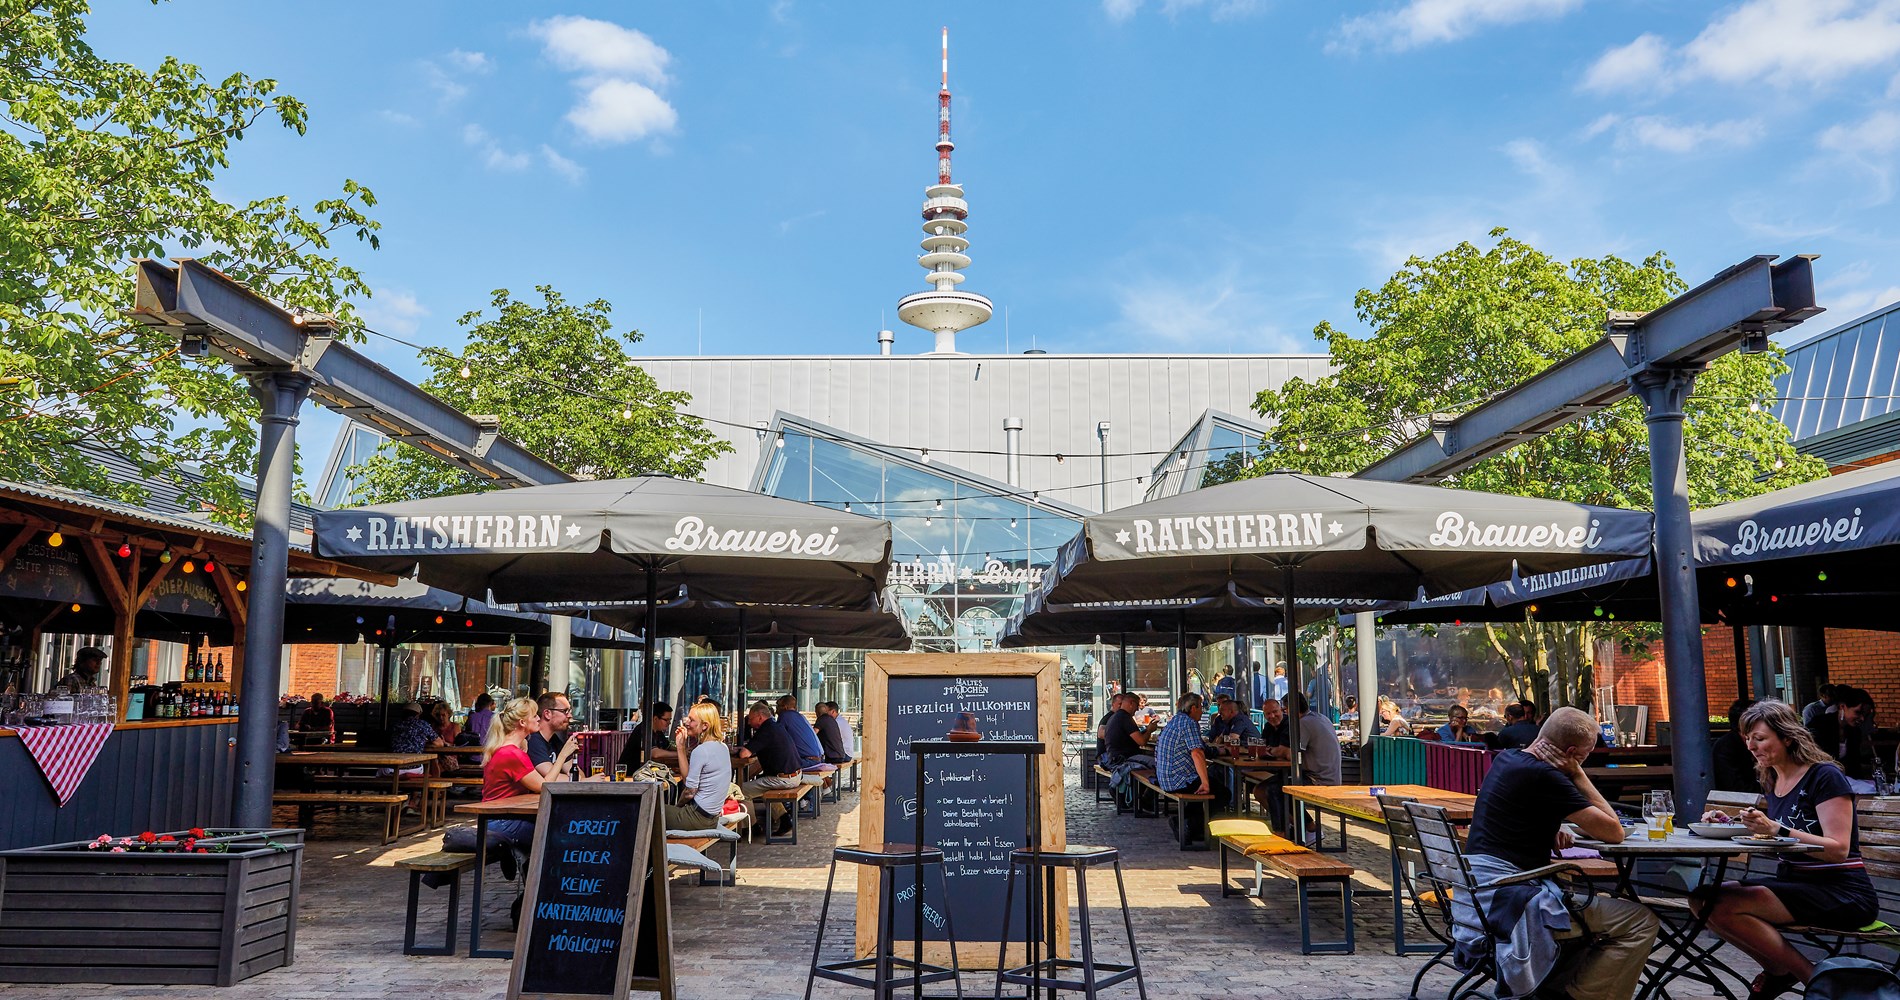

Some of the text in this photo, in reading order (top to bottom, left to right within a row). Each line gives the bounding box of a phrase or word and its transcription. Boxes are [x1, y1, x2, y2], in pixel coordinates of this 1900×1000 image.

[367, 515, 839, 556] RATSHERRN Brauerei
[1134, 511, 1602, 553] RATSHERRN Brauerei
[1731, 507, 1863, 556] Brauerei
[16, 558, 41, 573] BITTE
[886, 562, 956, 584] HERRN
[979, 560, 1043, 584] Brau
[159, 578, 218, 607] BIERAUSGABE
[960, 701, 1031, 712] WILLKOMMEN
[894, 750, 910, 760] Bitte
[923, 771, 934, 785] So
[962, 808, 993, 822] Bestellung
[995, 808, 1004, 818] ist
[568, 820, 620, 836] DERZEIT
[942, 835, 1016, 848] Wenn Ihr noch Essen
[562, 850, 611, 865] LEIDER
[989, 851, 1004, 861] lasst
[960, 864, 980, 876] Buzzer
[983, 866, 1024, 881] wiedergeen.
[560, 876, 604, 893] KEINE
[537, 902, 625, 926] KARTENZAHLUNG
